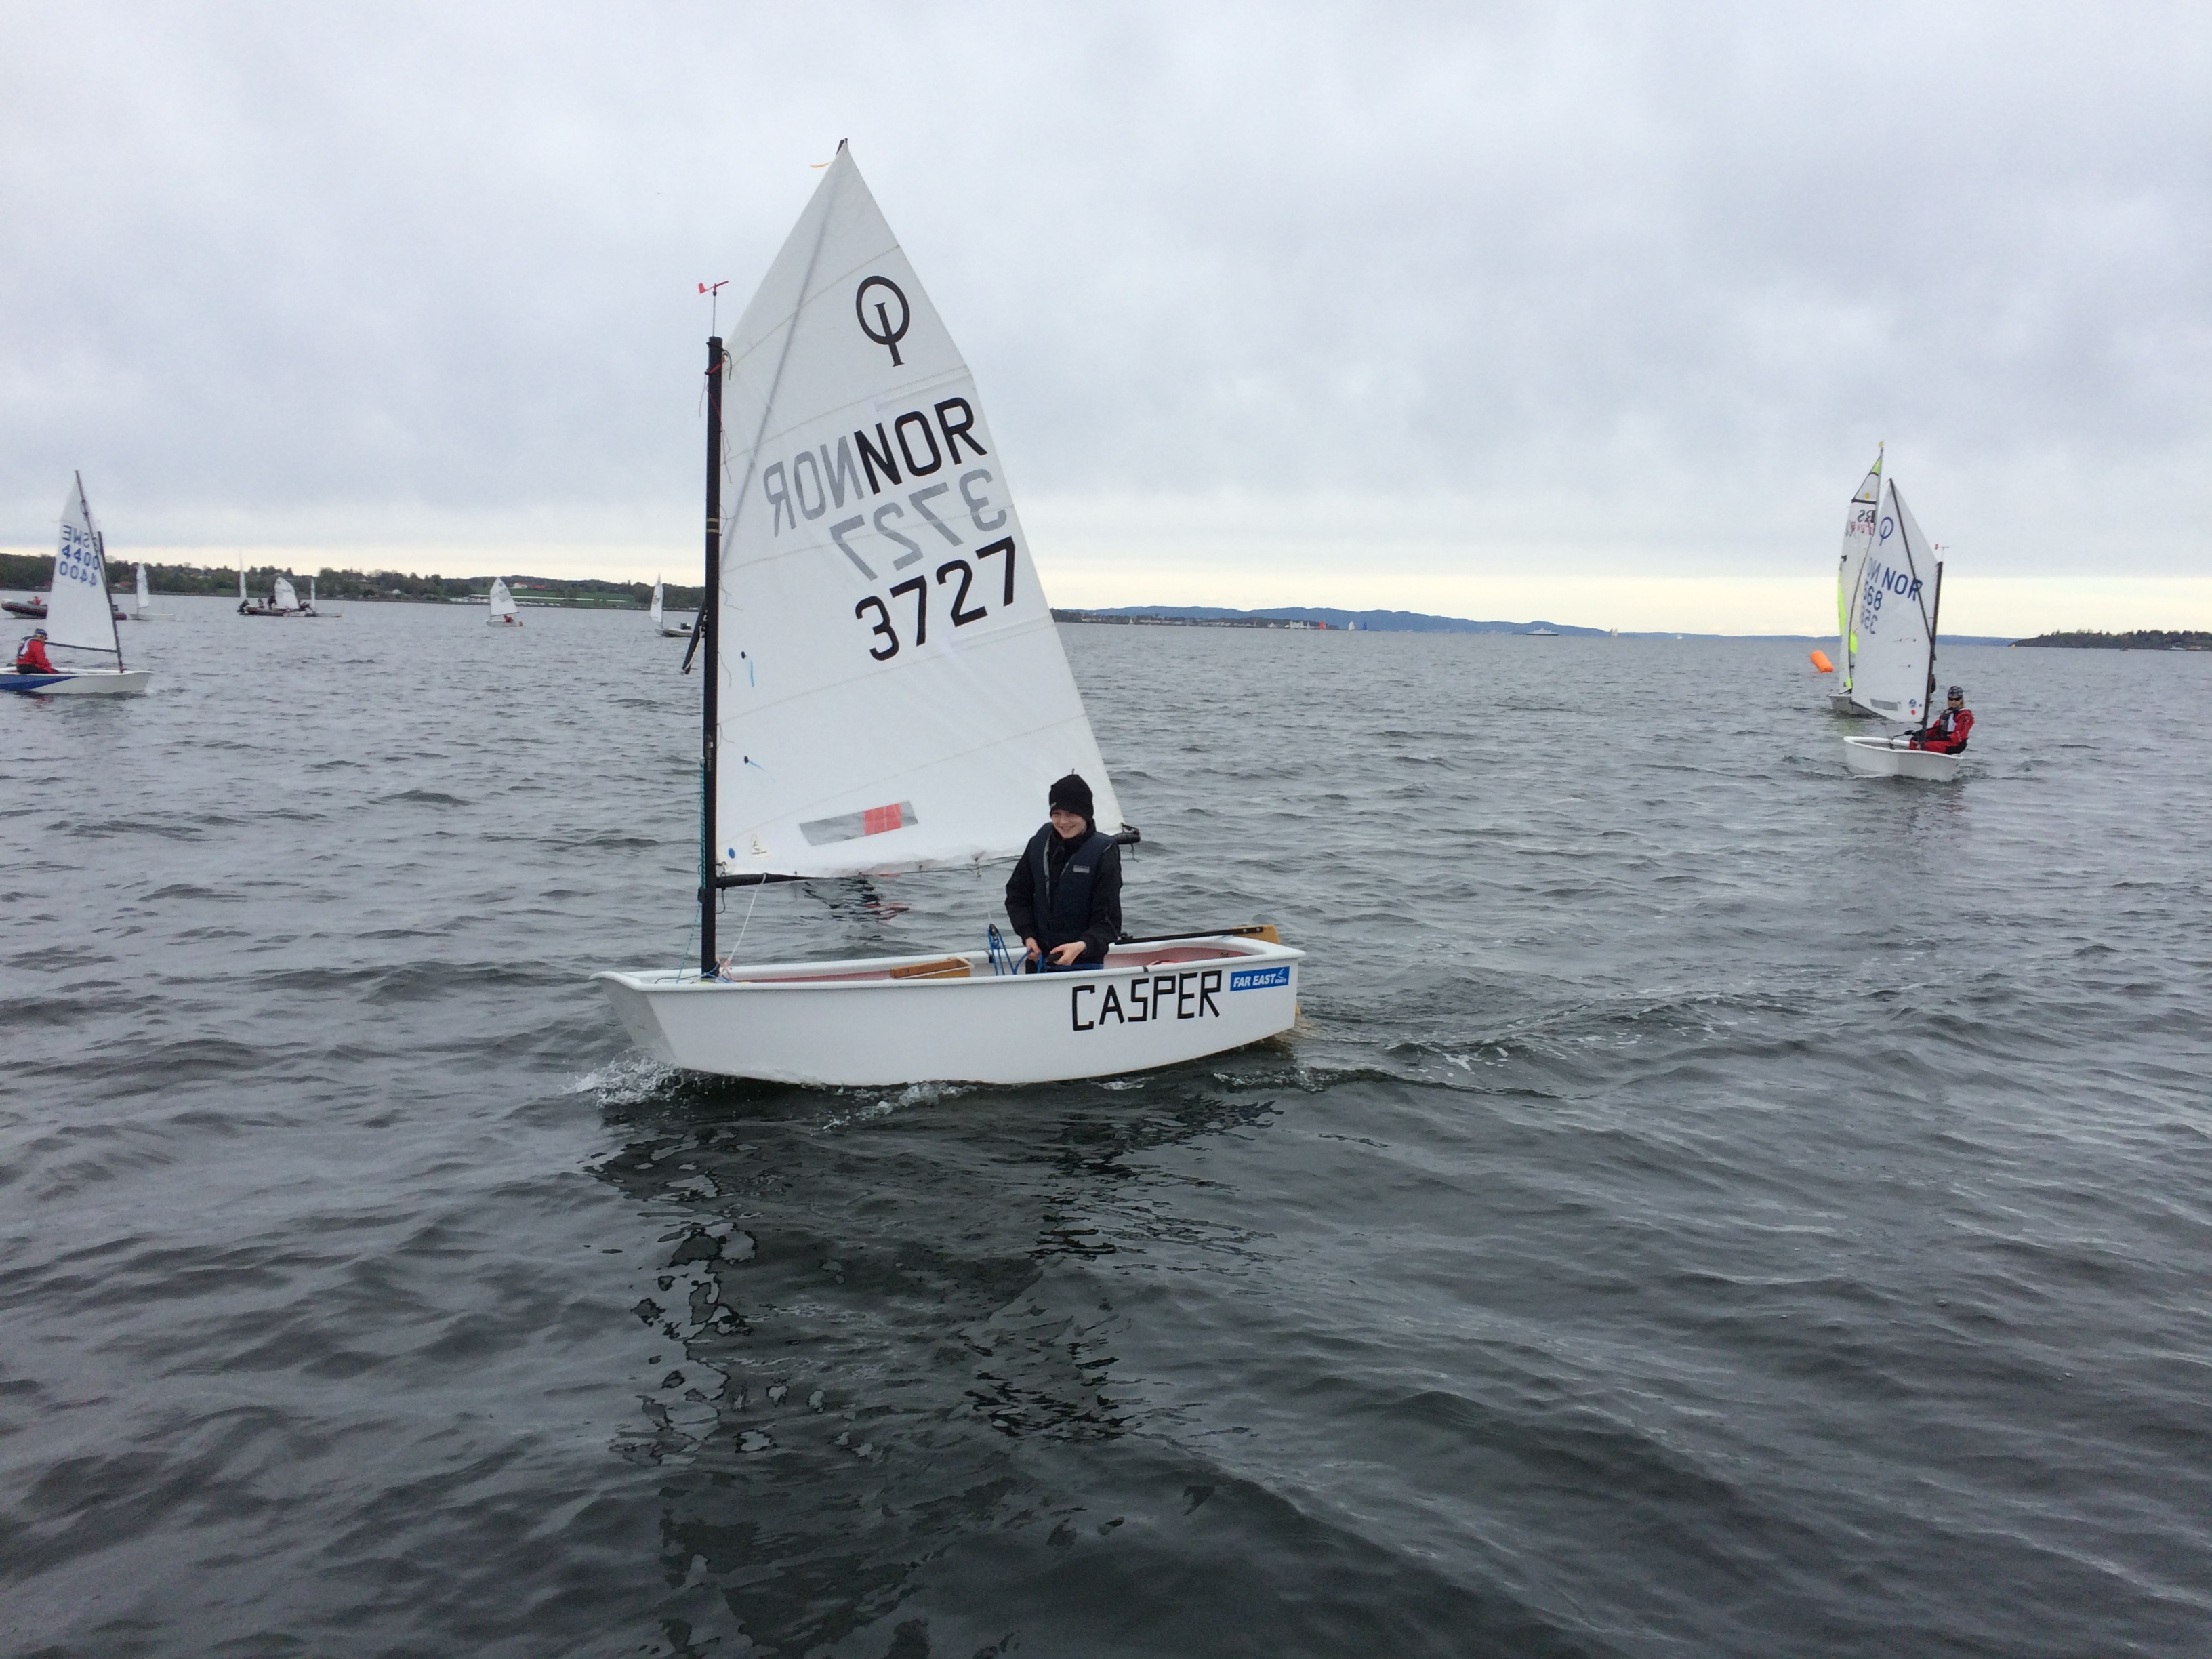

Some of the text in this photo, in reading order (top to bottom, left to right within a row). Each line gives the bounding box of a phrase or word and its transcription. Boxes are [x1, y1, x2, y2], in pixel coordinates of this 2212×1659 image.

[854, 397, 987, 495] NOR
[62, 544, 100, 570] 4400
[855, 536, 1016, 661] 3727
[1881, 567, 1923, 602] NOR
[1072, 970, 1222, 1031] CASPER
[1233, 976, 1252, 988] FAR
[1252, 973, 1277, 986] EAST
